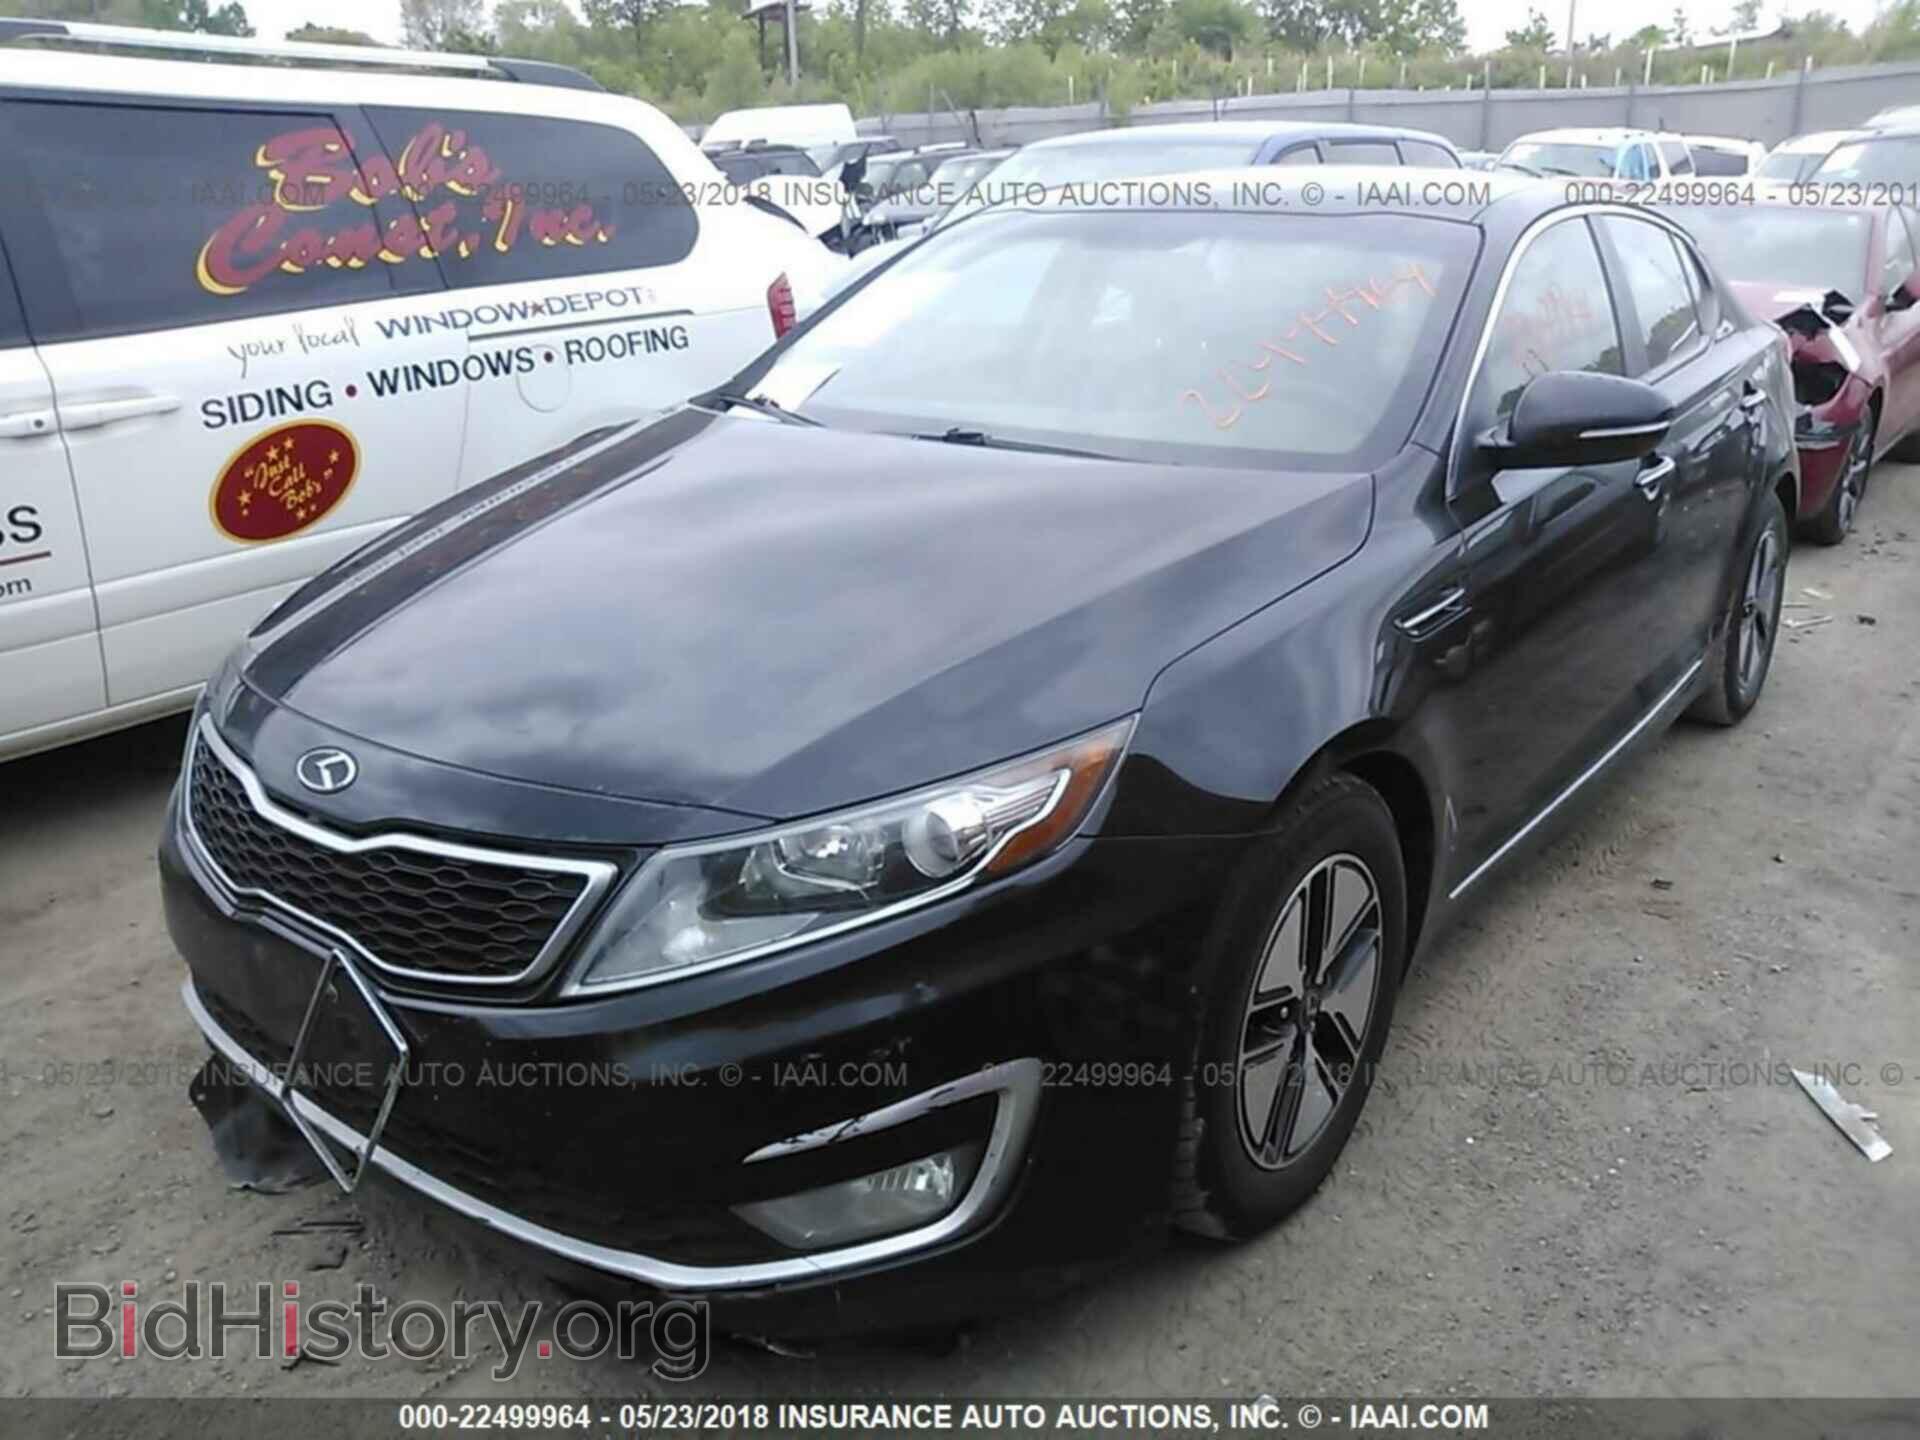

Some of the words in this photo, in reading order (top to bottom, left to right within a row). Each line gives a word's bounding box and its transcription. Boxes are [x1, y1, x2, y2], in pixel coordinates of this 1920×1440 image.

[227, 340, 286, 379] your
[292, 316, 361, 354] local
[375, 300, 531, 340] WINDOW
[550, 286, 643, 316] DEPOT
[201, 379, 334, 429] SIDING
[366, 347, 536, 397] WINDOWS
[564, 326, 690, 364] ROOFING
[269, 461, 306, 497] Call
[0, 505, 42, 547] S
[0, 578, 32, 598] m
